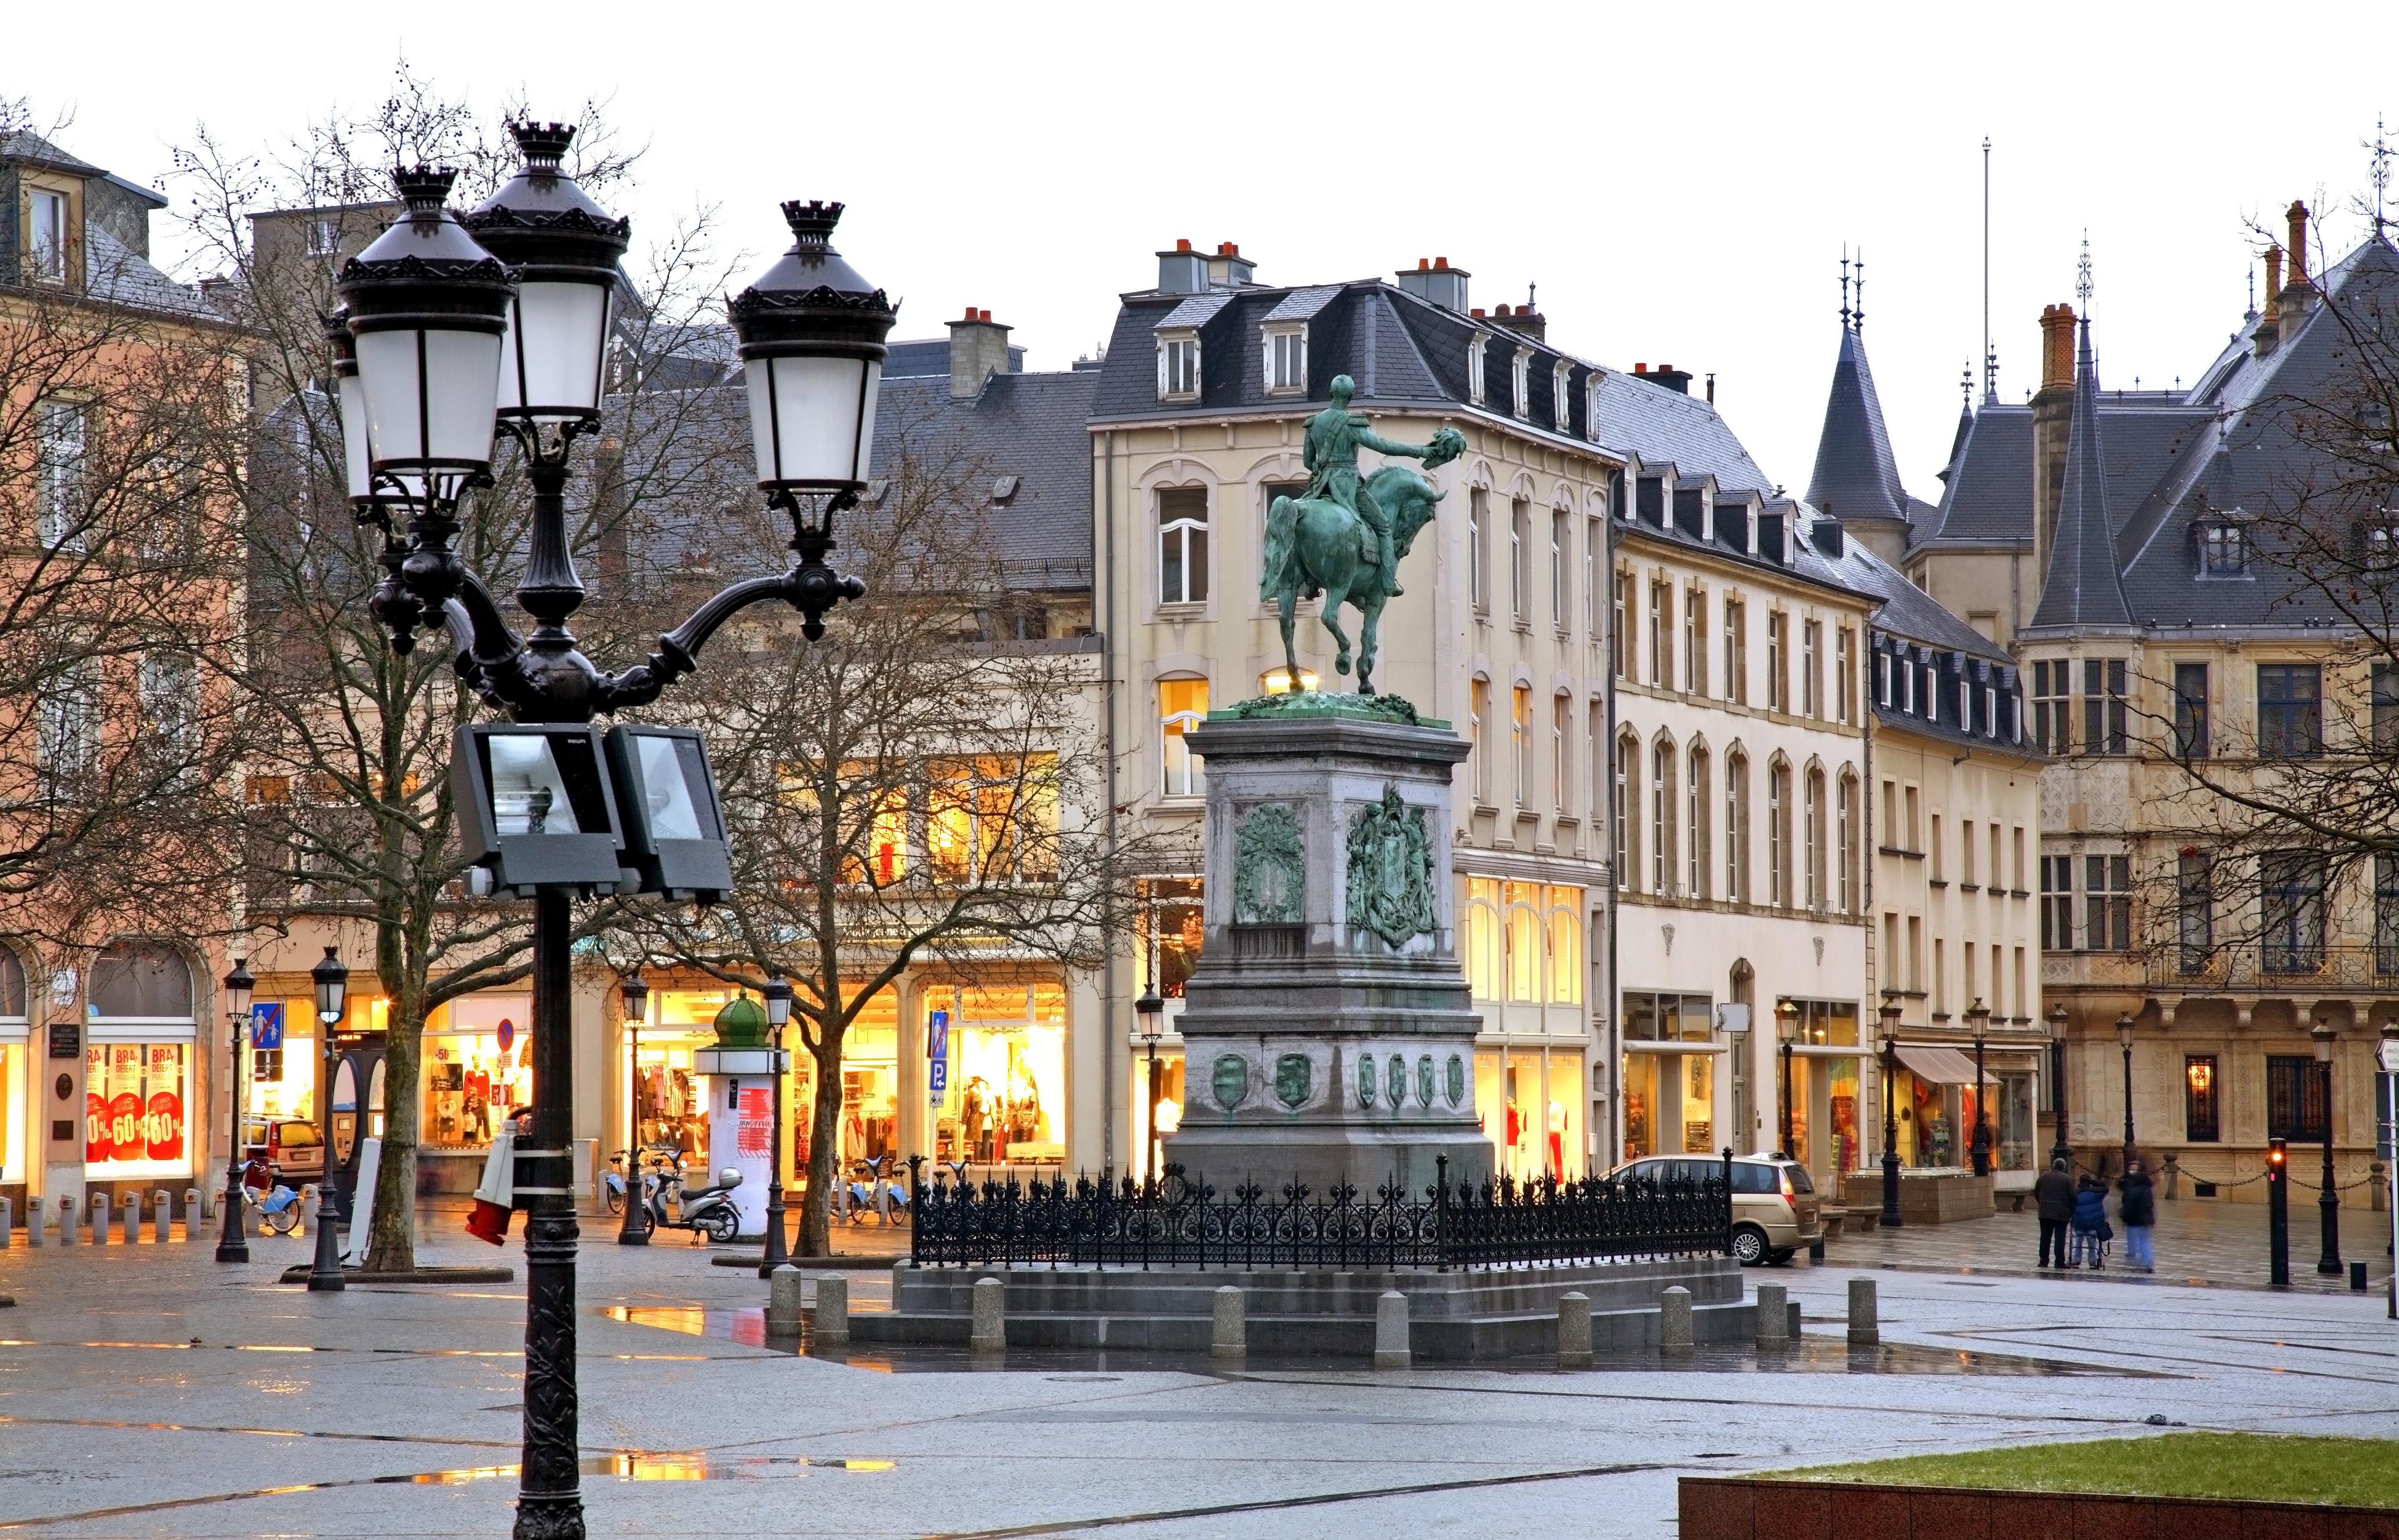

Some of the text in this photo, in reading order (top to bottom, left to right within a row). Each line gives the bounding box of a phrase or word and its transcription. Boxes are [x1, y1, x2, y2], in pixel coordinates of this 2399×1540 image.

[908, 924, 931, 938] parti
[435, 1049, 449, 1060] -50
[933, 1063, 944, 1087] P
